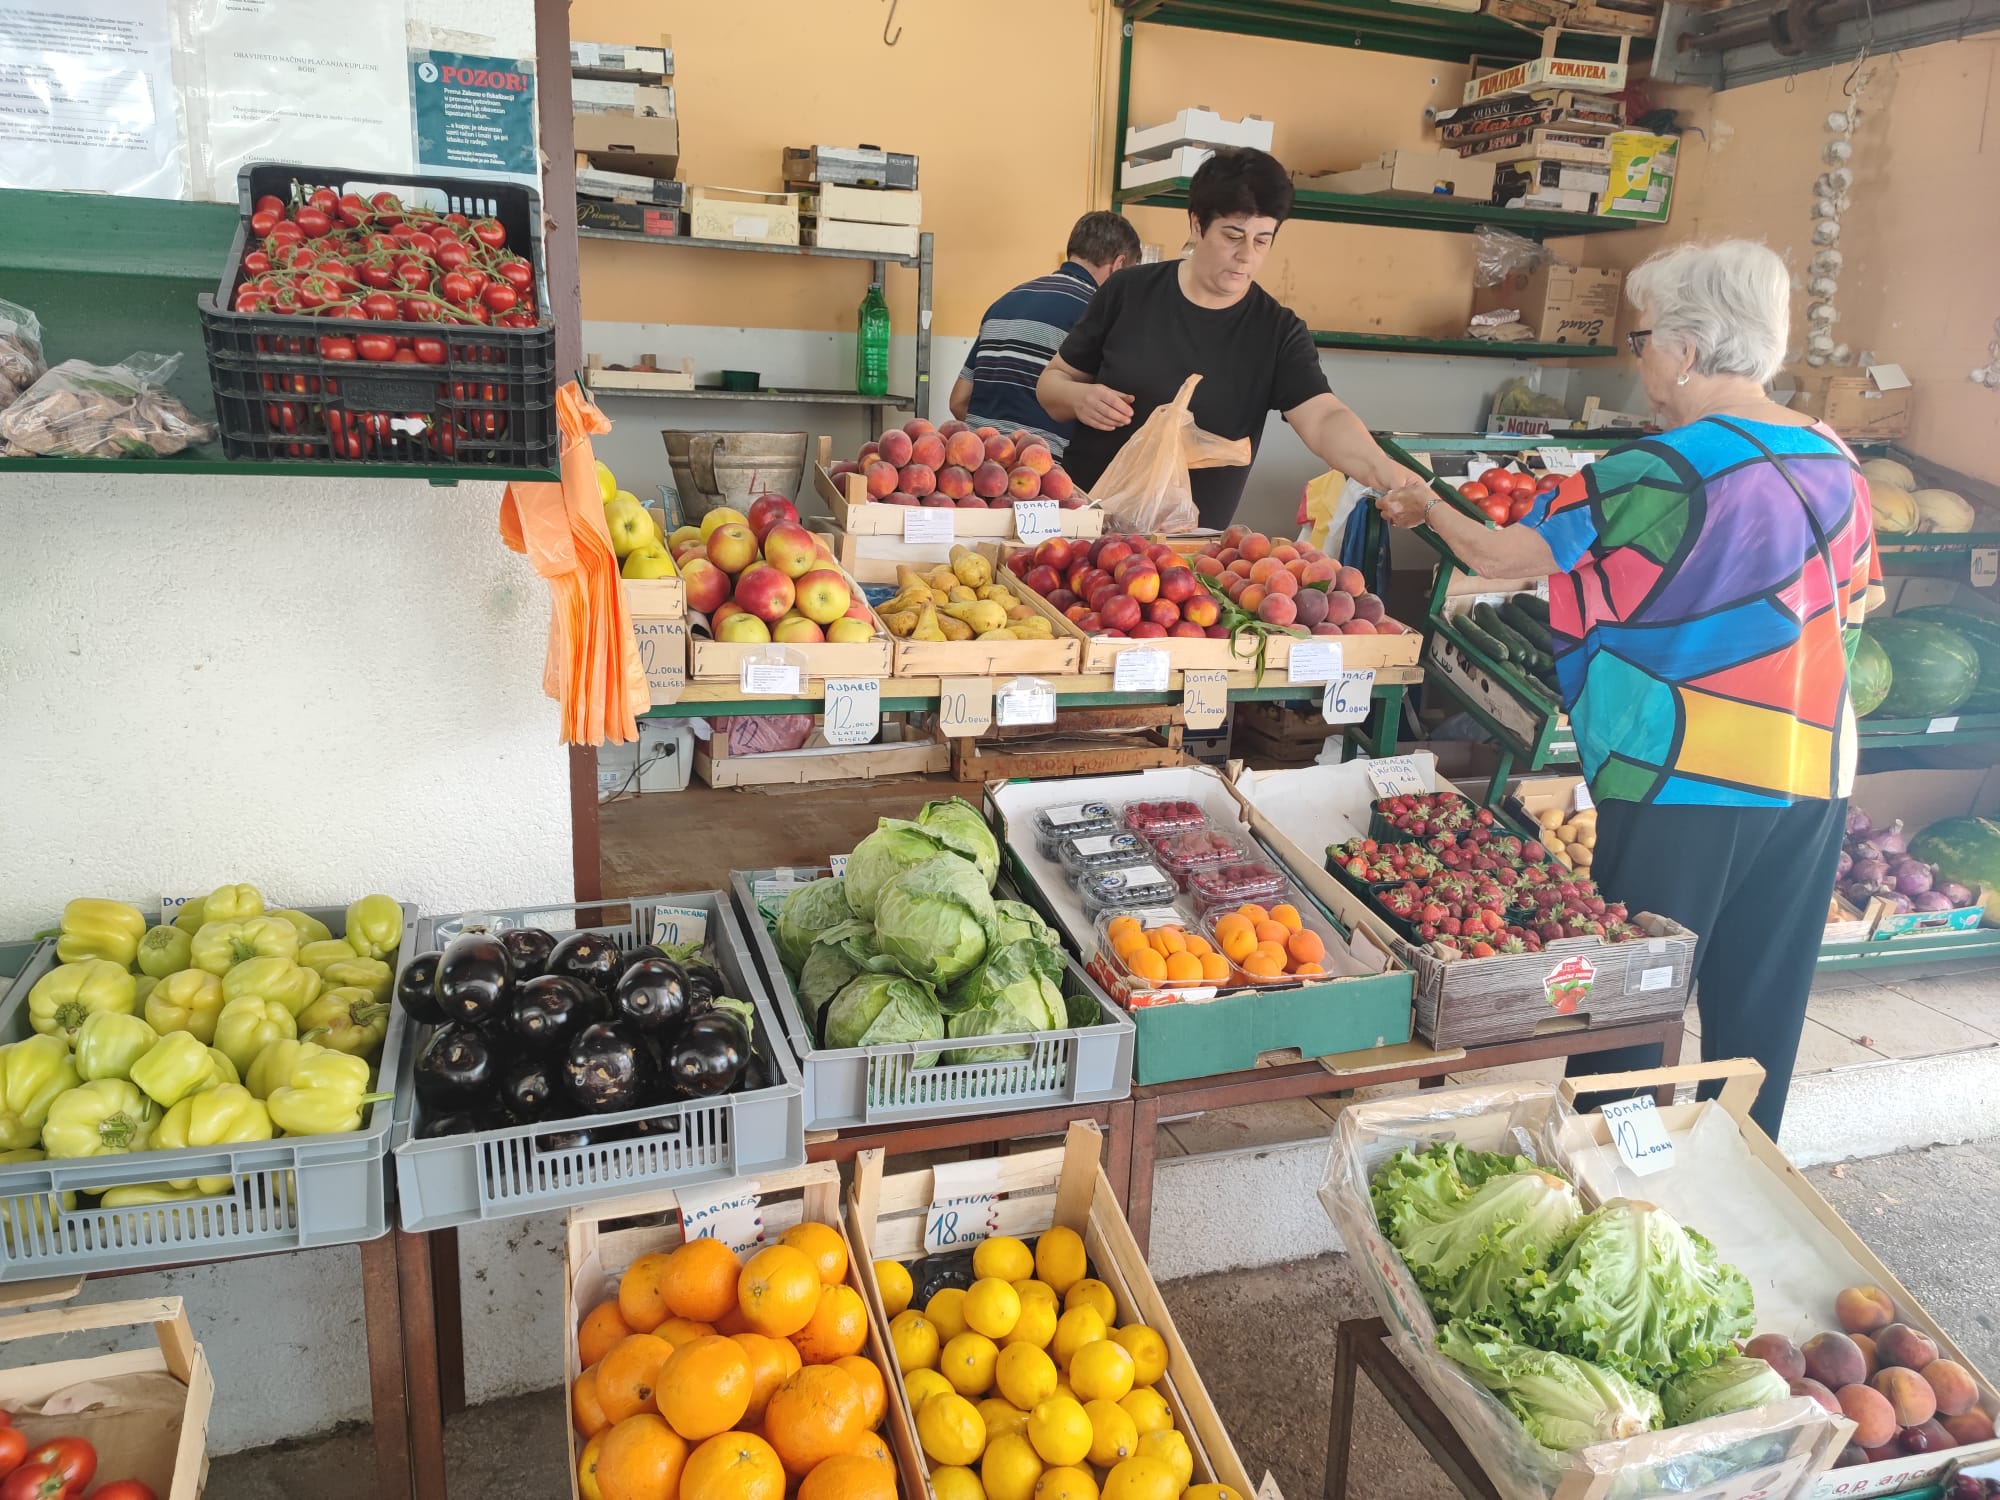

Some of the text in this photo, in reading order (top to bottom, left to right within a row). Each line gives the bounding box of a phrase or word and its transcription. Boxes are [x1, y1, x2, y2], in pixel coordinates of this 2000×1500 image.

[441, 65, 529, 92] POZOR!
[1550, 61, 1607, 81] PRIMAVERA
[1477, 66, 1526, 98] PRIMAVERA
[1557, 318, 1605, 337] Eland
[633, 624, 684, 634] SLATKA
